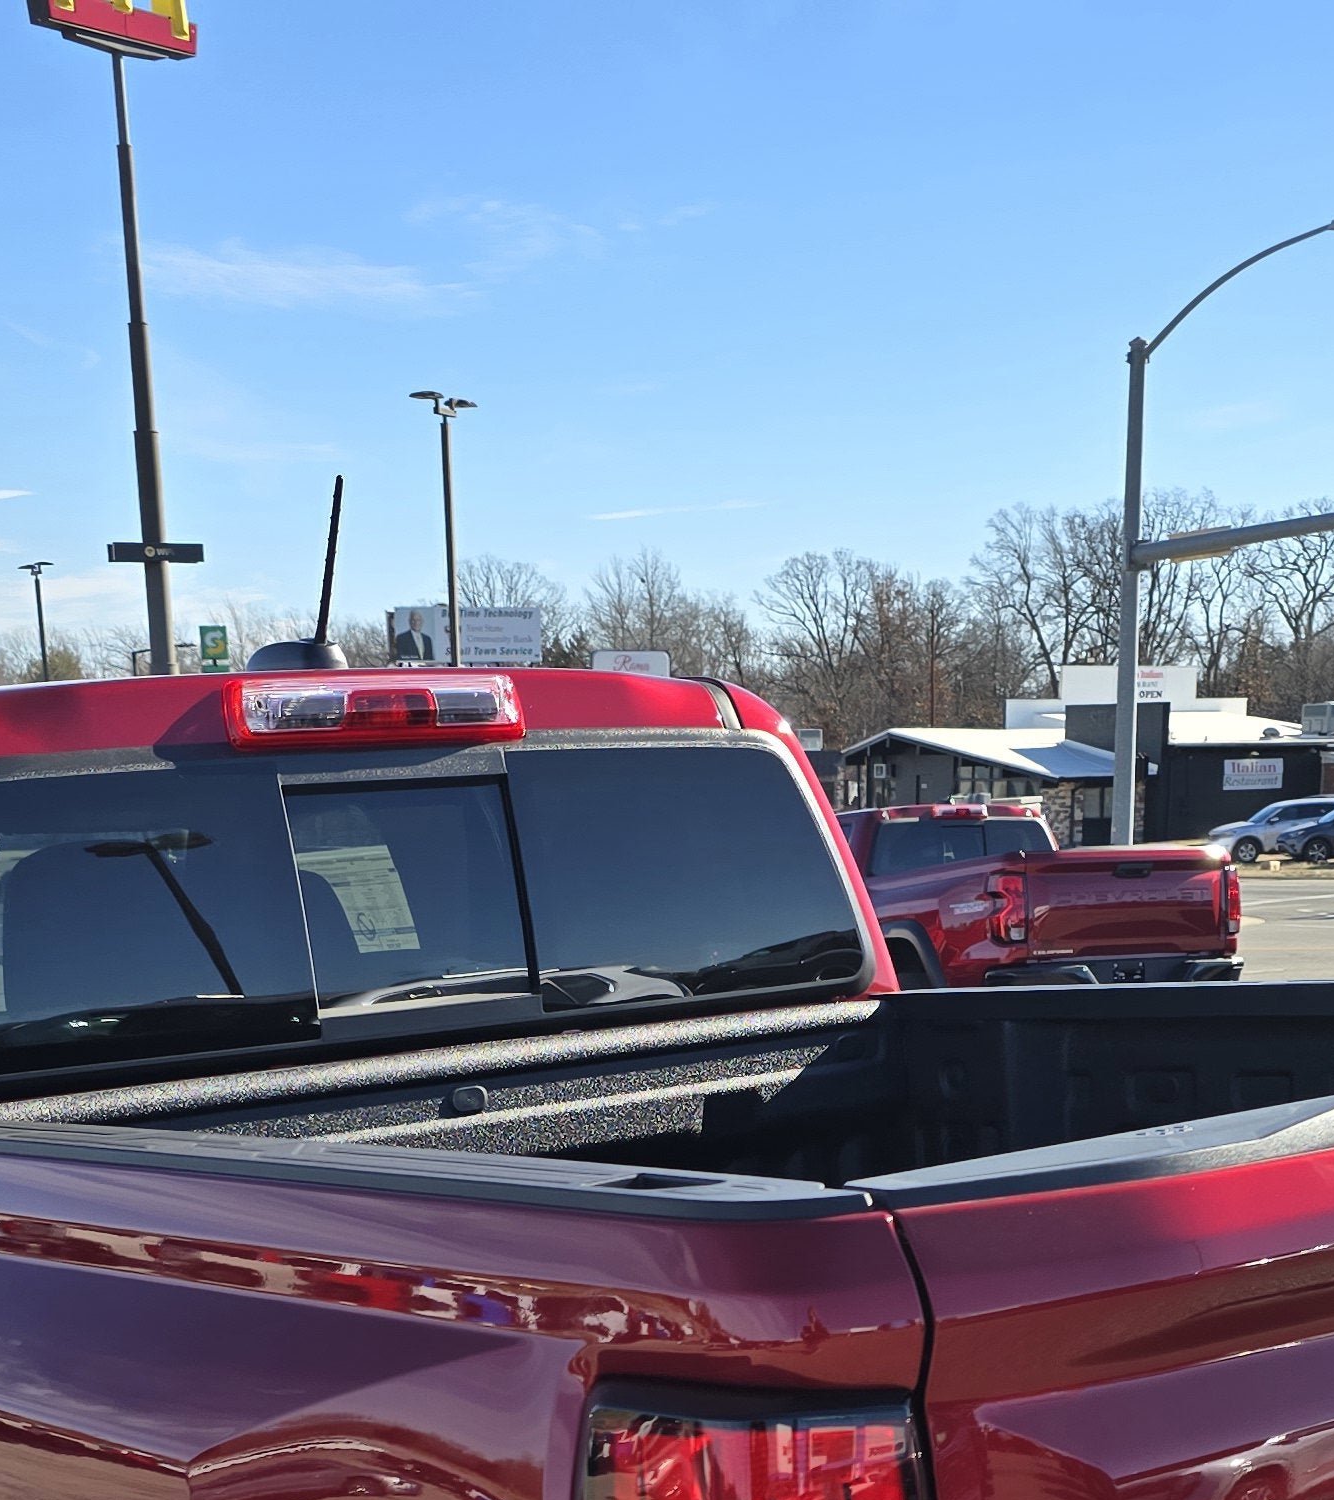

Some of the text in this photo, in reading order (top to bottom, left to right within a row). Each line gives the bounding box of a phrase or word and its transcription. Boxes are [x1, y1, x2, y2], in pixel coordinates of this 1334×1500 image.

[483, 608, 534, 620] Technology
[474, 647, 497, 656] Town
[500, 646, 534, 656] Service
[1139, 690, 1163, 699] OPEN
[1232, 762, 1277, 773] Italian
